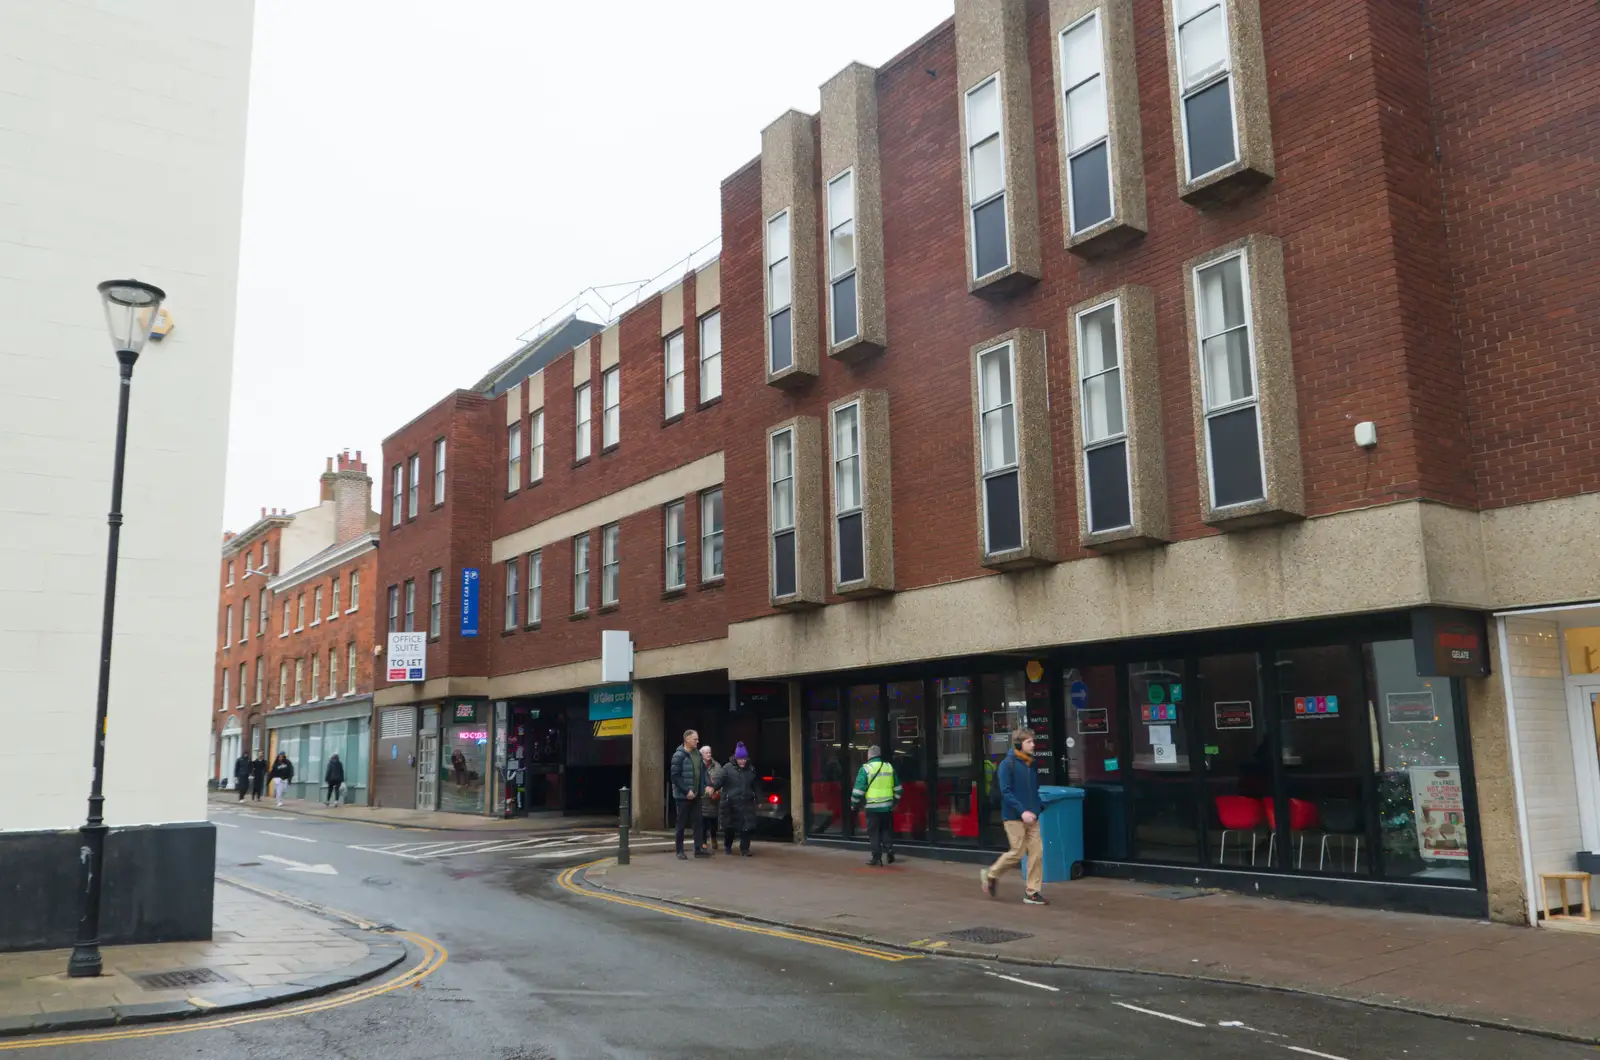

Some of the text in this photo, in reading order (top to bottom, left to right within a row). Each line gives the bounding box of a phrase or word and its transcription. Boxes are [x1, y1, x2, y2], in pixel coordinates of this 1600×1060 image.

[392, 635, 422, 643] OFFICE
[395, 643, 420, 652] SUITE
[391, 658, 422, 667] TO LET
